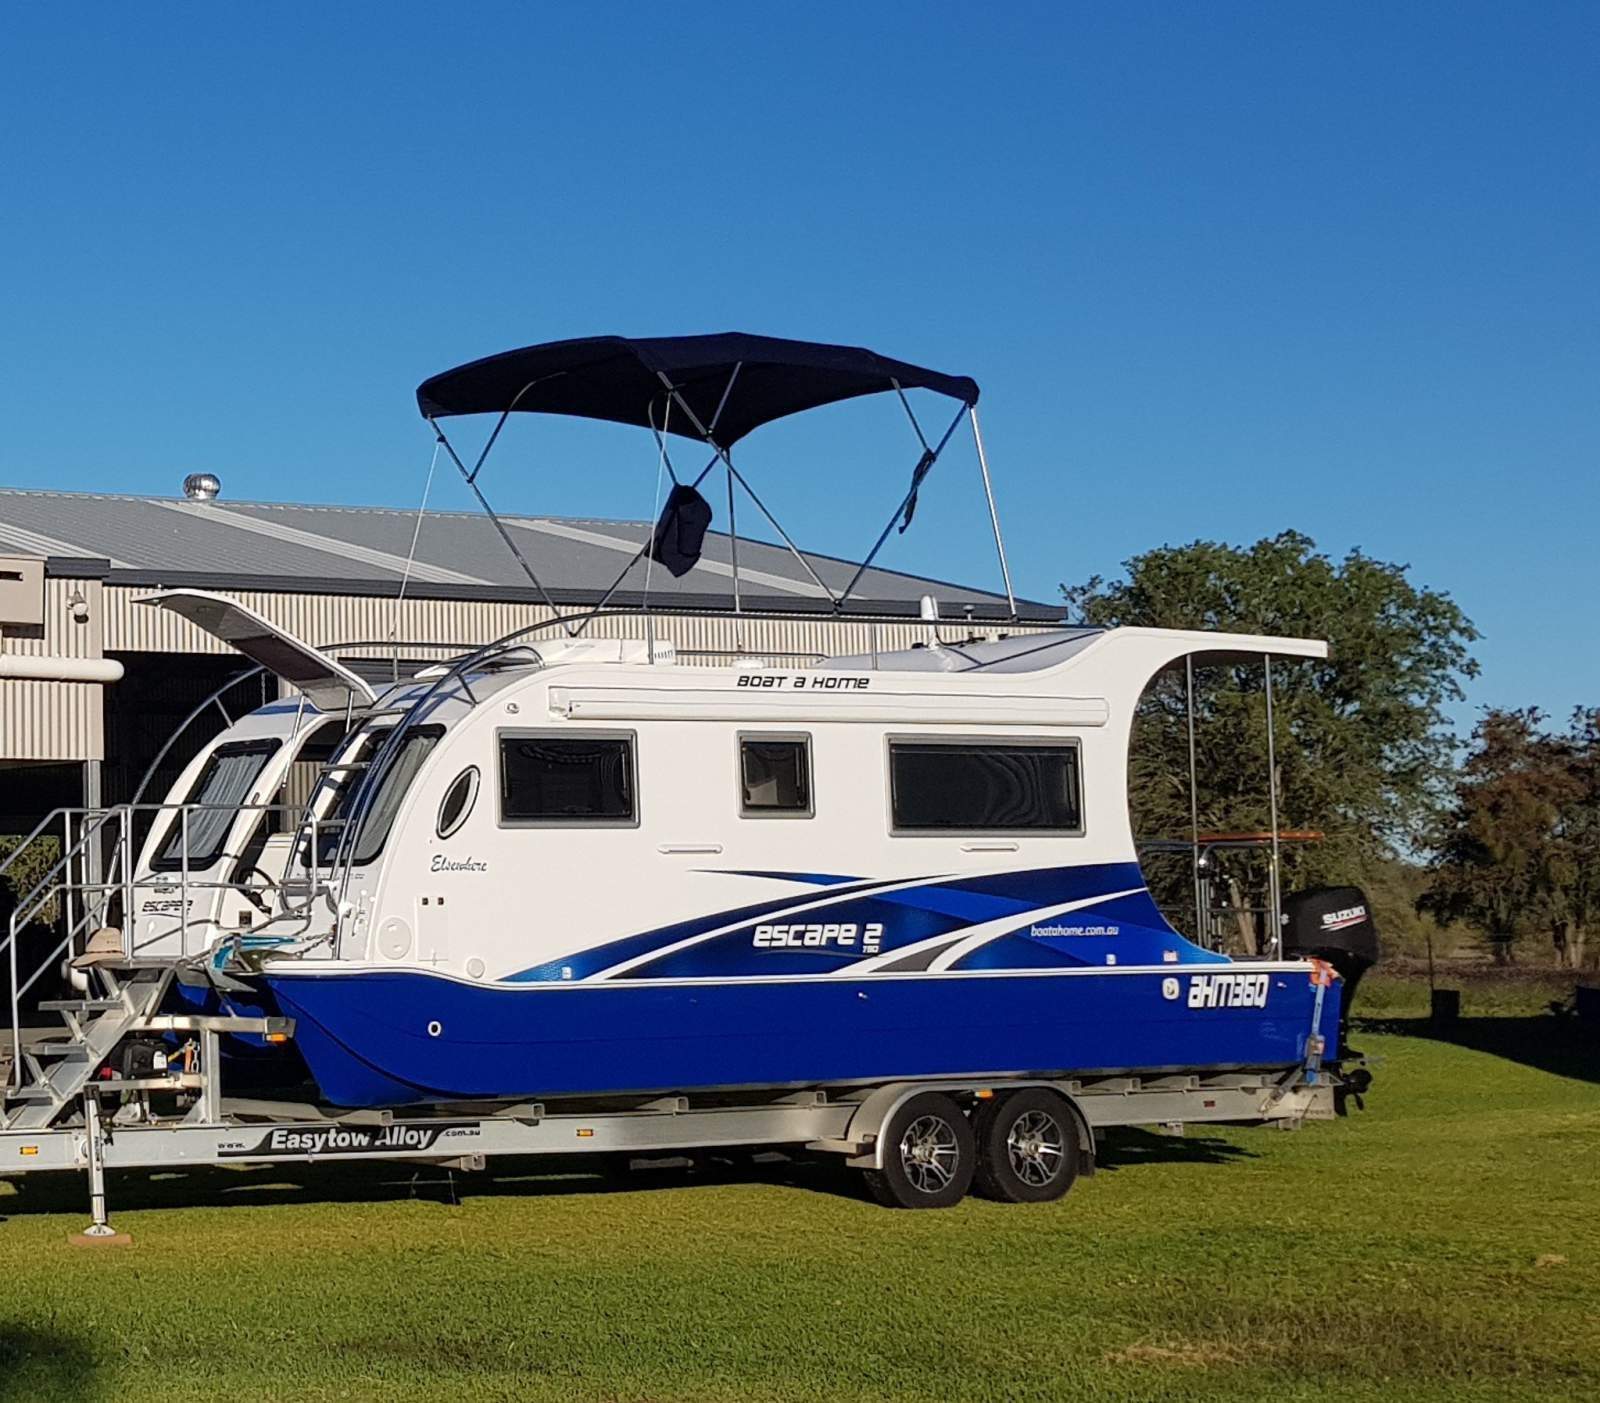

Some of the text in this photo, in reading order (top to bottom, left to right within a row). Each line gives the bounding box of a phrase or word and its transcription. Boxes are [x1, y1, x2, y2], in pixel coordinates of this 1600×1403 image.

[1322, 905, 1366, 924] SUZUKI
[863, 923, 883, 945] 2
[1031, 924, 1119, 937] boatahome.com.au
[271, 1128, 371, 1153] Easytow
[374, 1126, 433, 1149] Alloy
